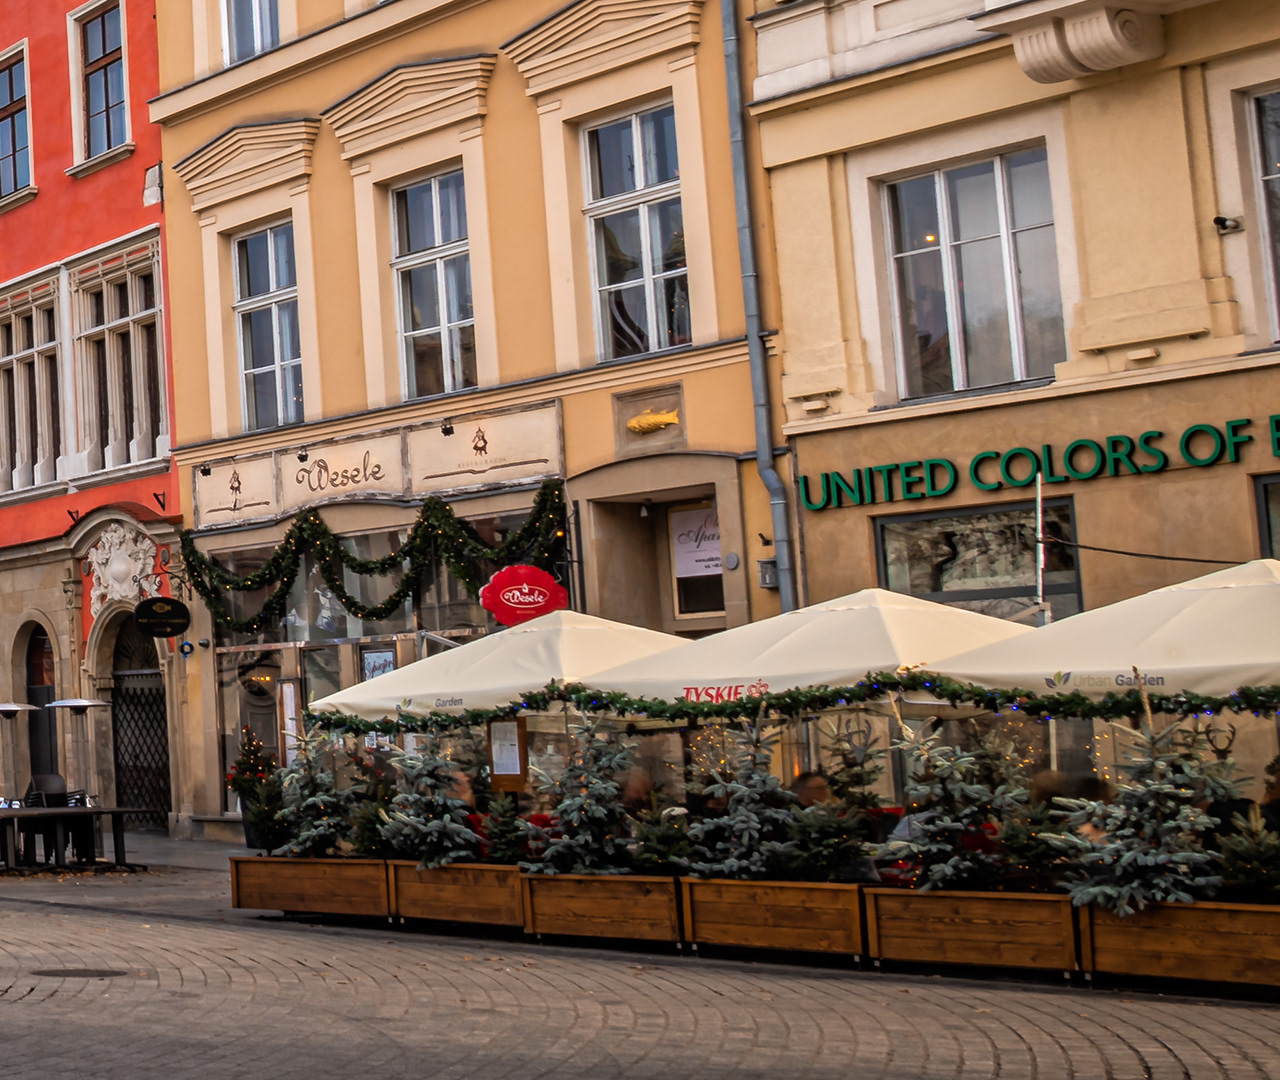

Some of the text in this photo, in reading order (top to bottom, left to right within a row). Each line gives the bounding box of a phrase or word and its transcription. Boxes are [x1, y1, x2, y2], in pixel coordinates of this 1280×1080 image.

[295, 449, 386, 492] Wesele
[798, 457, 957, 511] UNITED
[969, 430, 1168, 491] COLORS
[1179, 418, 1254, 467] OF
[503, 589, 544, 603] Wesele
[434, 696, 463, 708] Garden
[682, 684, 745, 704] TYSKIE
